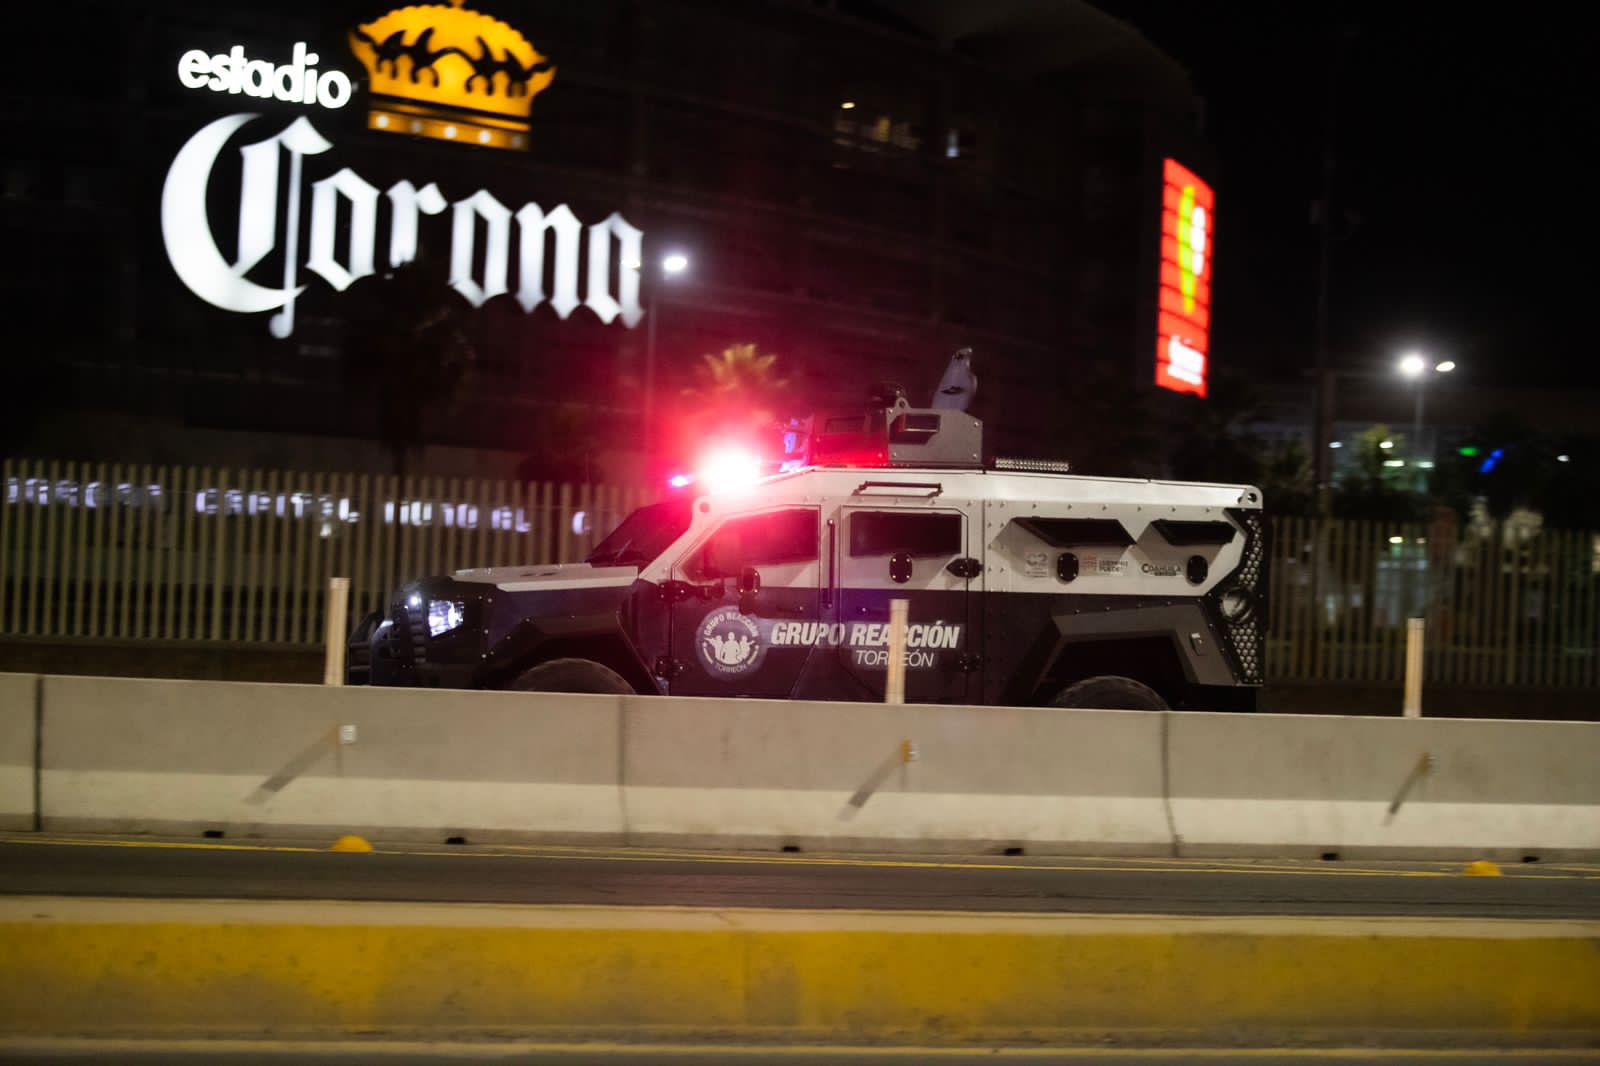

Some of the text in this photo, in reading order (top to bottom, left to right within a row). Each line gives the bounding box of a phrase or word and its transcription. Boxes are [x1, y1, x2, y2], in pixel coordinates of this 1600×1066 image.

[178, 42, 352, 109] estadio
[161, 113, 645, 338] Corona
[770, 620, 961, 649] GRUPO REACIÓN
[855, 649, 935, 668] TOREÓN
